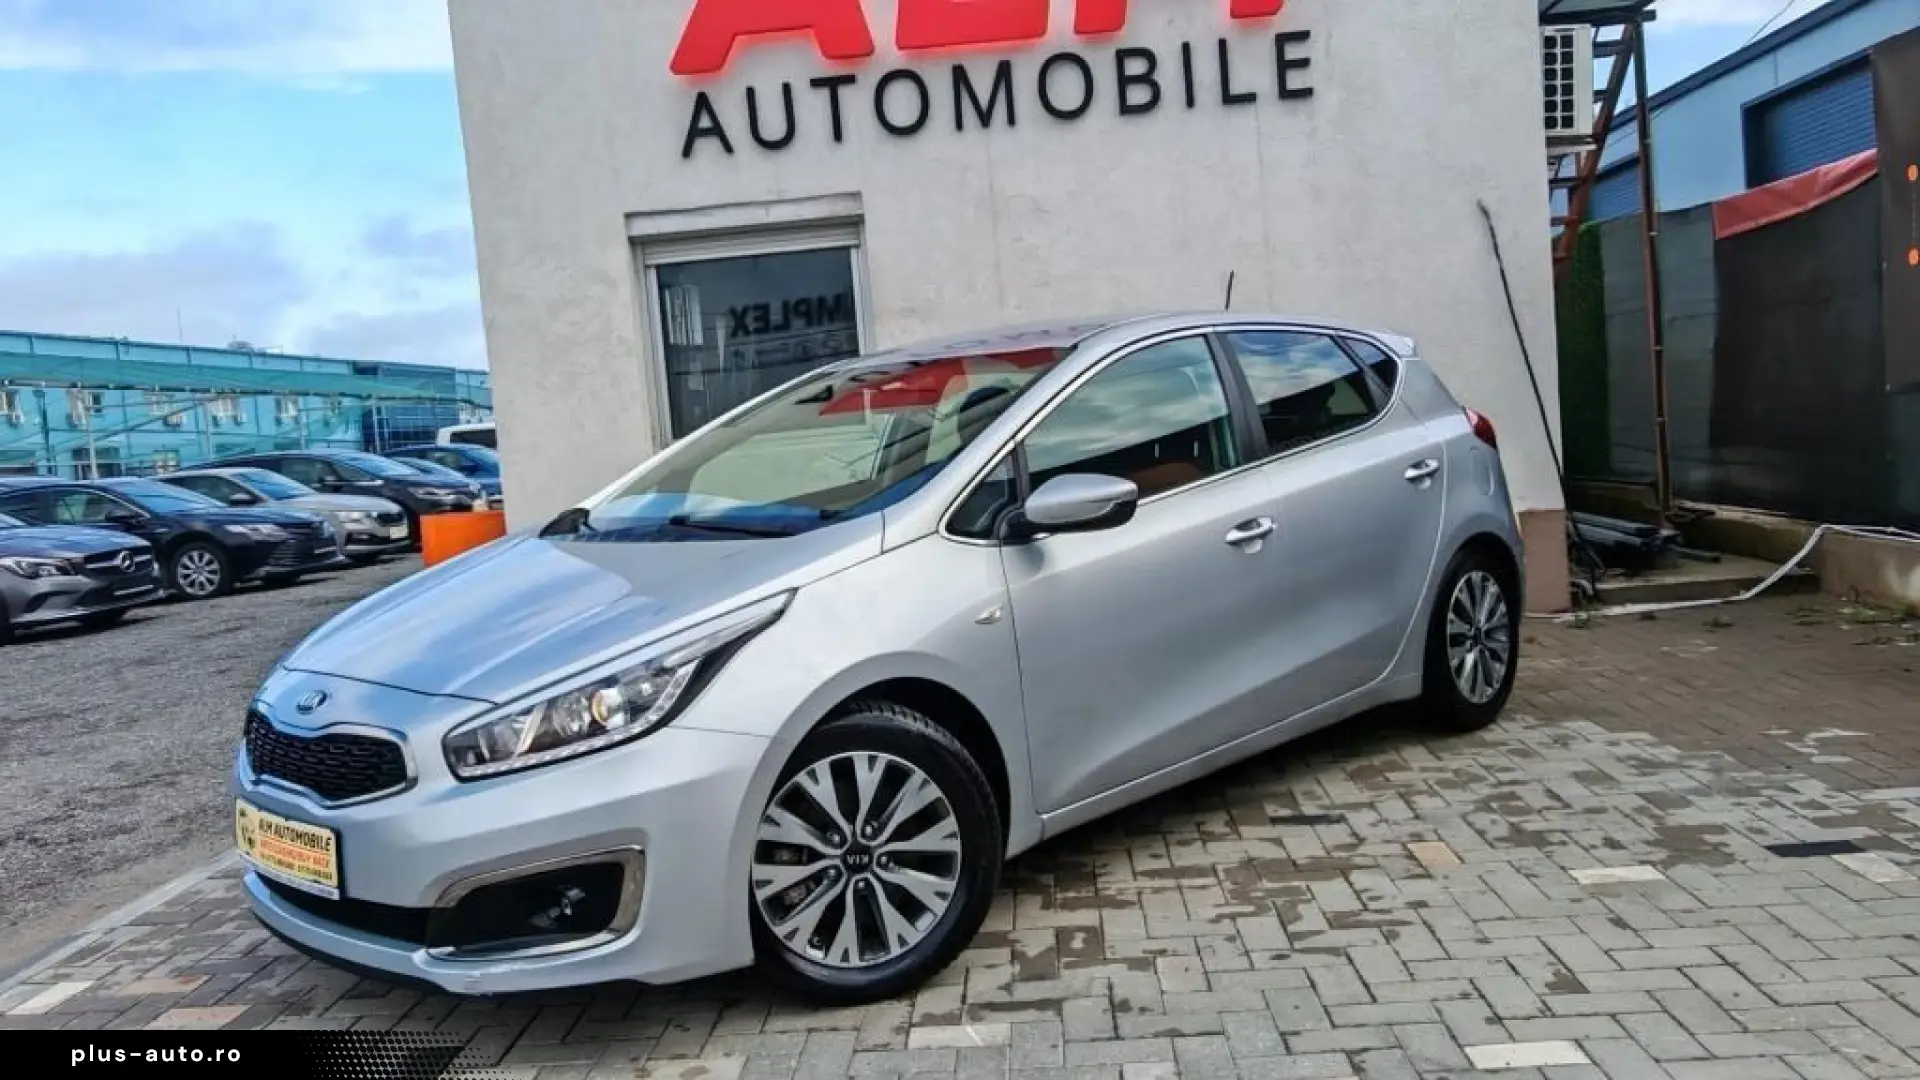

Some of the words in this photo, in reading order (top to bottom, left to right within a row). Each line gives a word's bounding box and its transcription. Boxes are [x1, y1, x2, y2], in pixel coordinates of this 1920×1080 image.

[682, 30, 1314, 158] AUTOMOBILE
[273, 822, 333, 852] AUTOMOBILE
[847, 854, 869, 865] KIA
